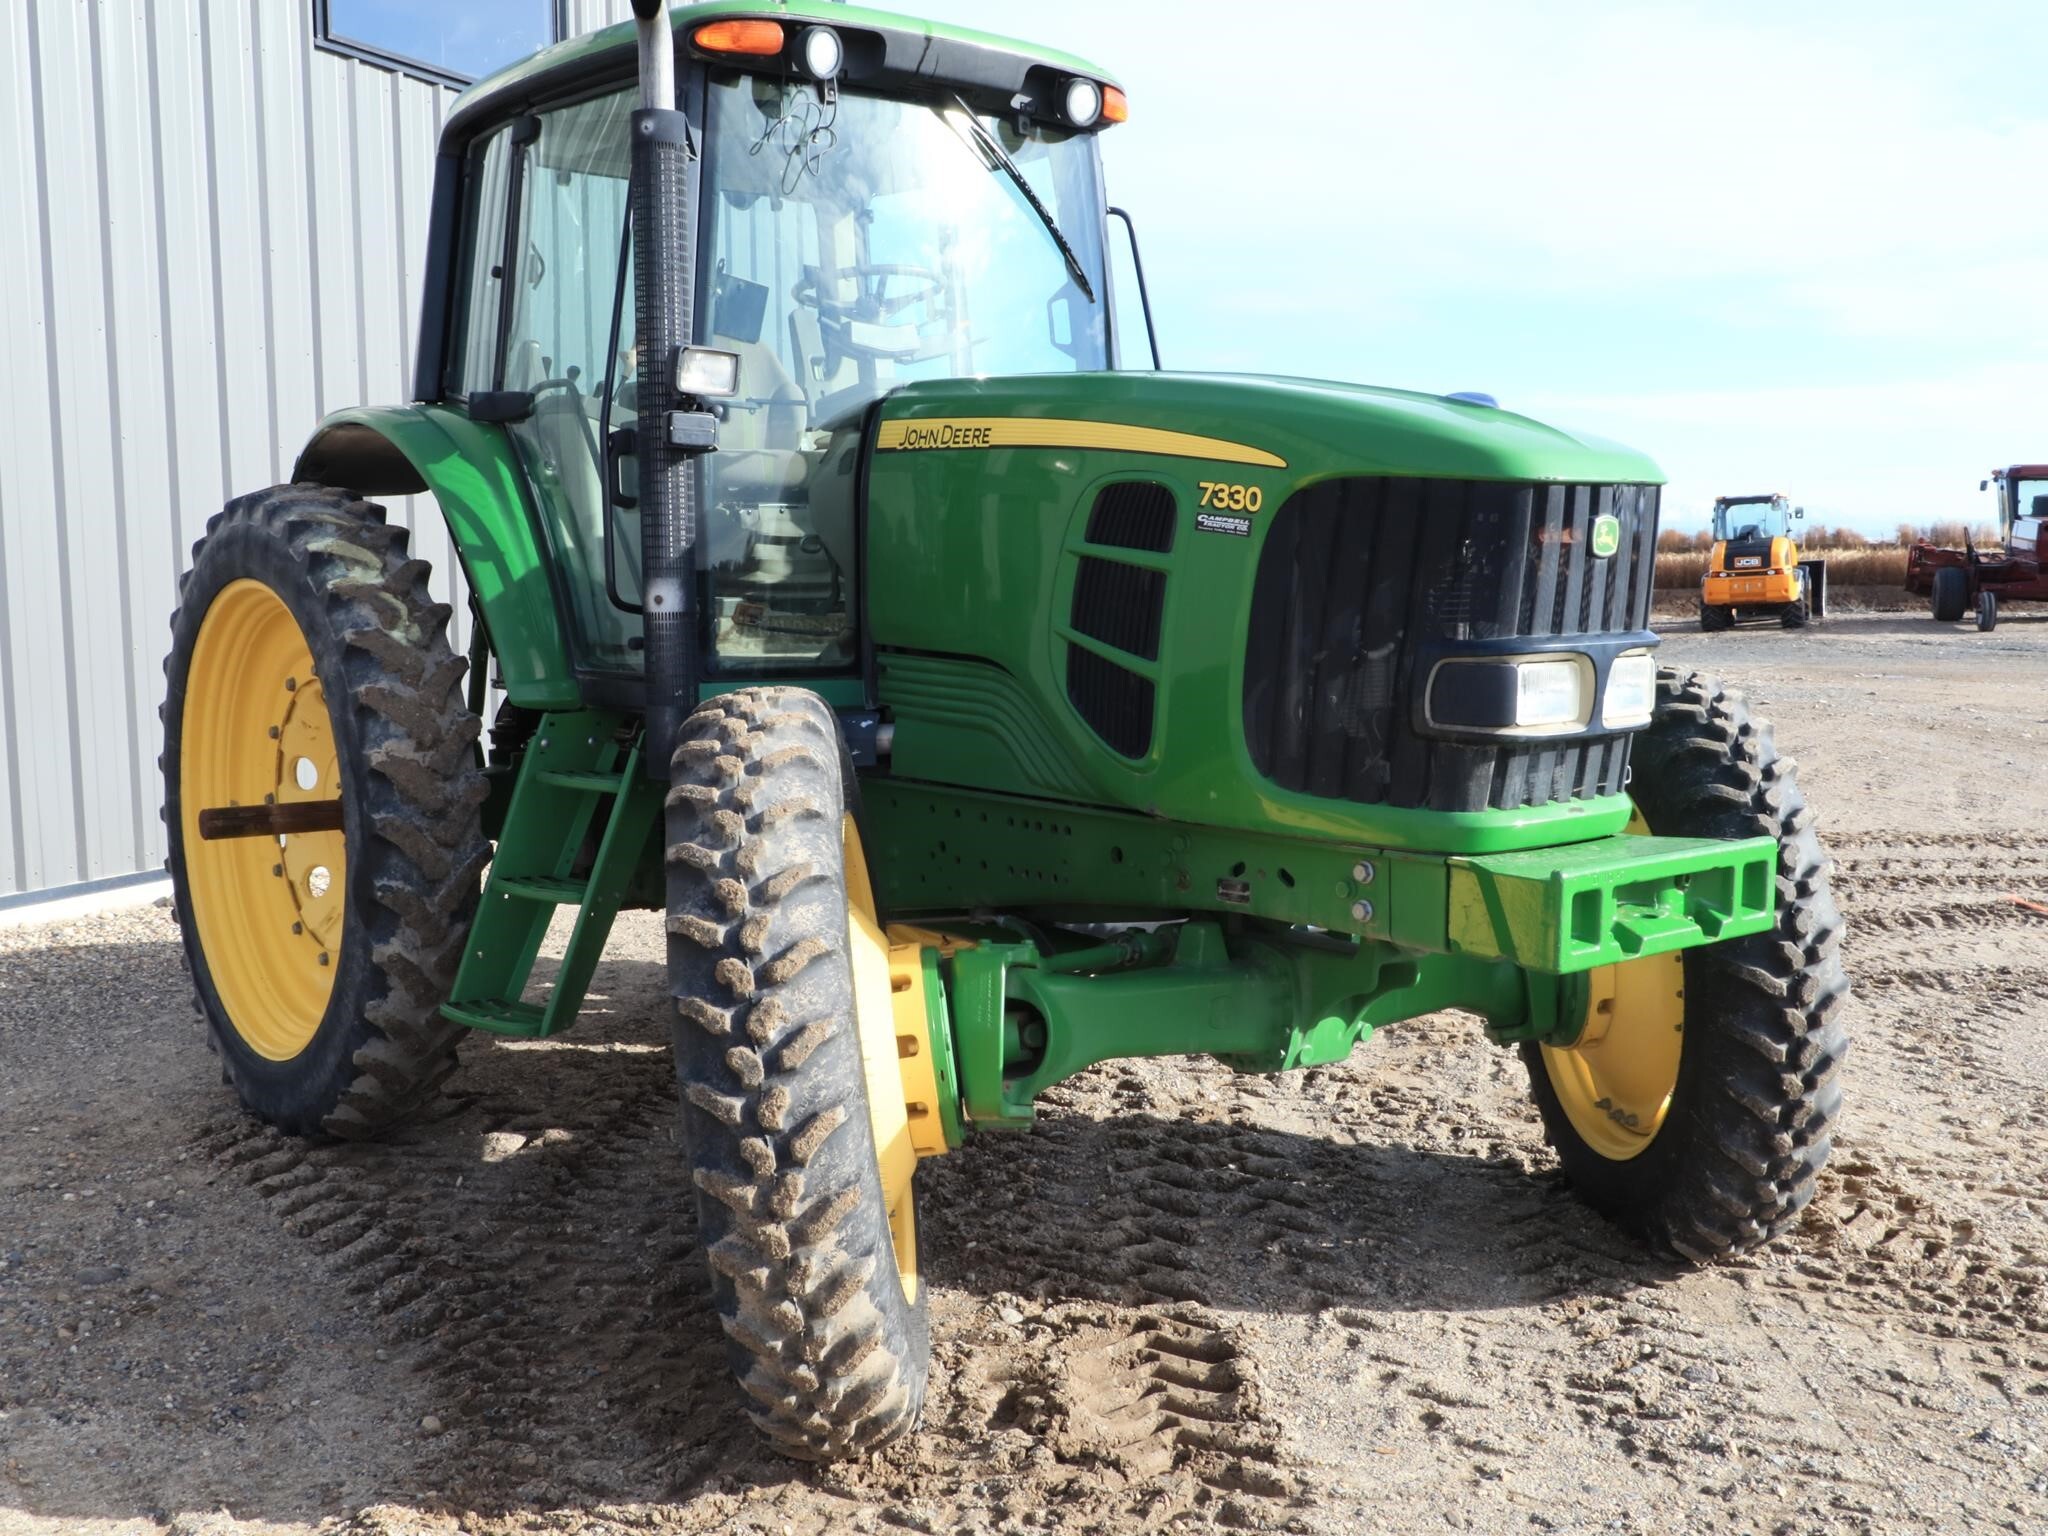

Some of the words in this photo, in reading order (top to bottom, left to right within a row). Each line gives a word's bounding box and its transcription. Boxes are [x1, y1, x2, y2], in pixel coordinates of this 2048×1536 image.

[899, 426, 940, 446] JOHN
[940, 425, 992, 446] DEERE
[1199, 481, 1262, 512] 7330
[1197, 514, 1249, 525] CAMPBELL
[1736, 558, 1759, 566] JCB
